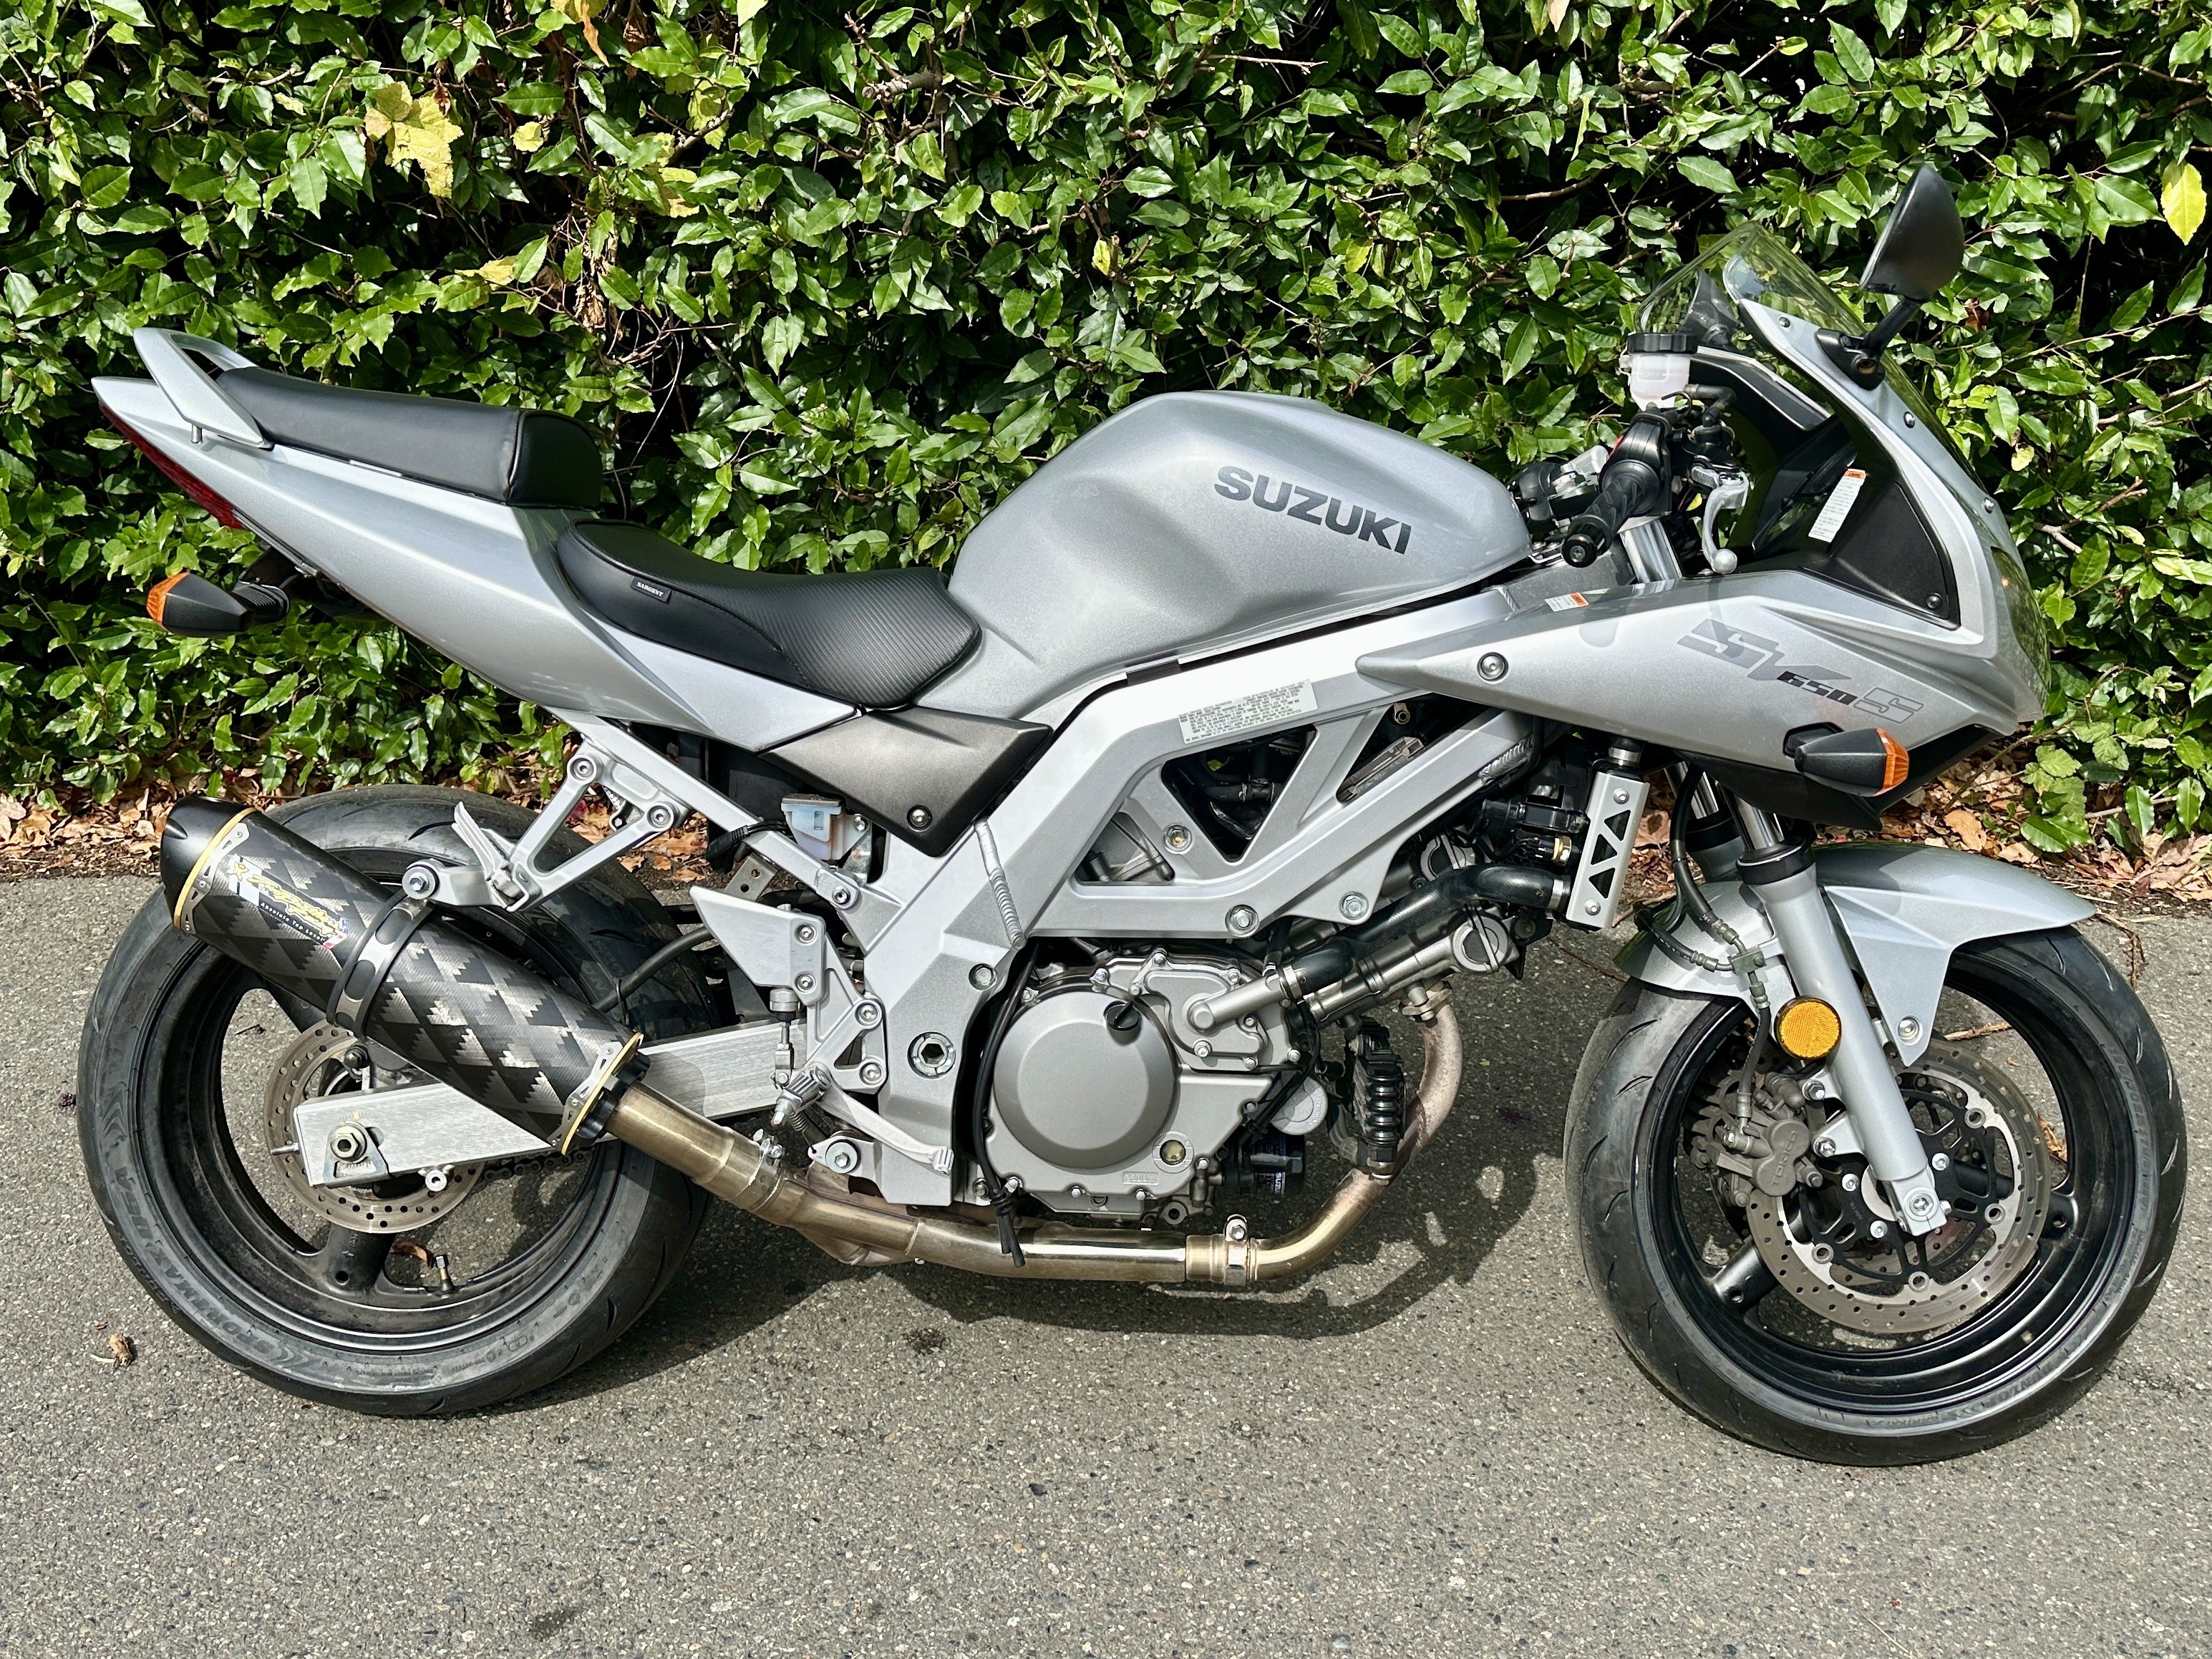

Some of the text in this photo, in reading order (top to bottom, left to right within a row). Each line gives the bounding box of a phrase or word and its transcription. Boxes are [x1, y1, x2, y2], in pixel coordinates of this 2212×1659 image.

[1214, 466, 1412, 555] SUZUKI
[1677, 618, 1924, 724] SV 650 S
[1772, 1131, 1795, 1184] TOKICO
[147, 1247, 273, 1354] SPORTMAX
